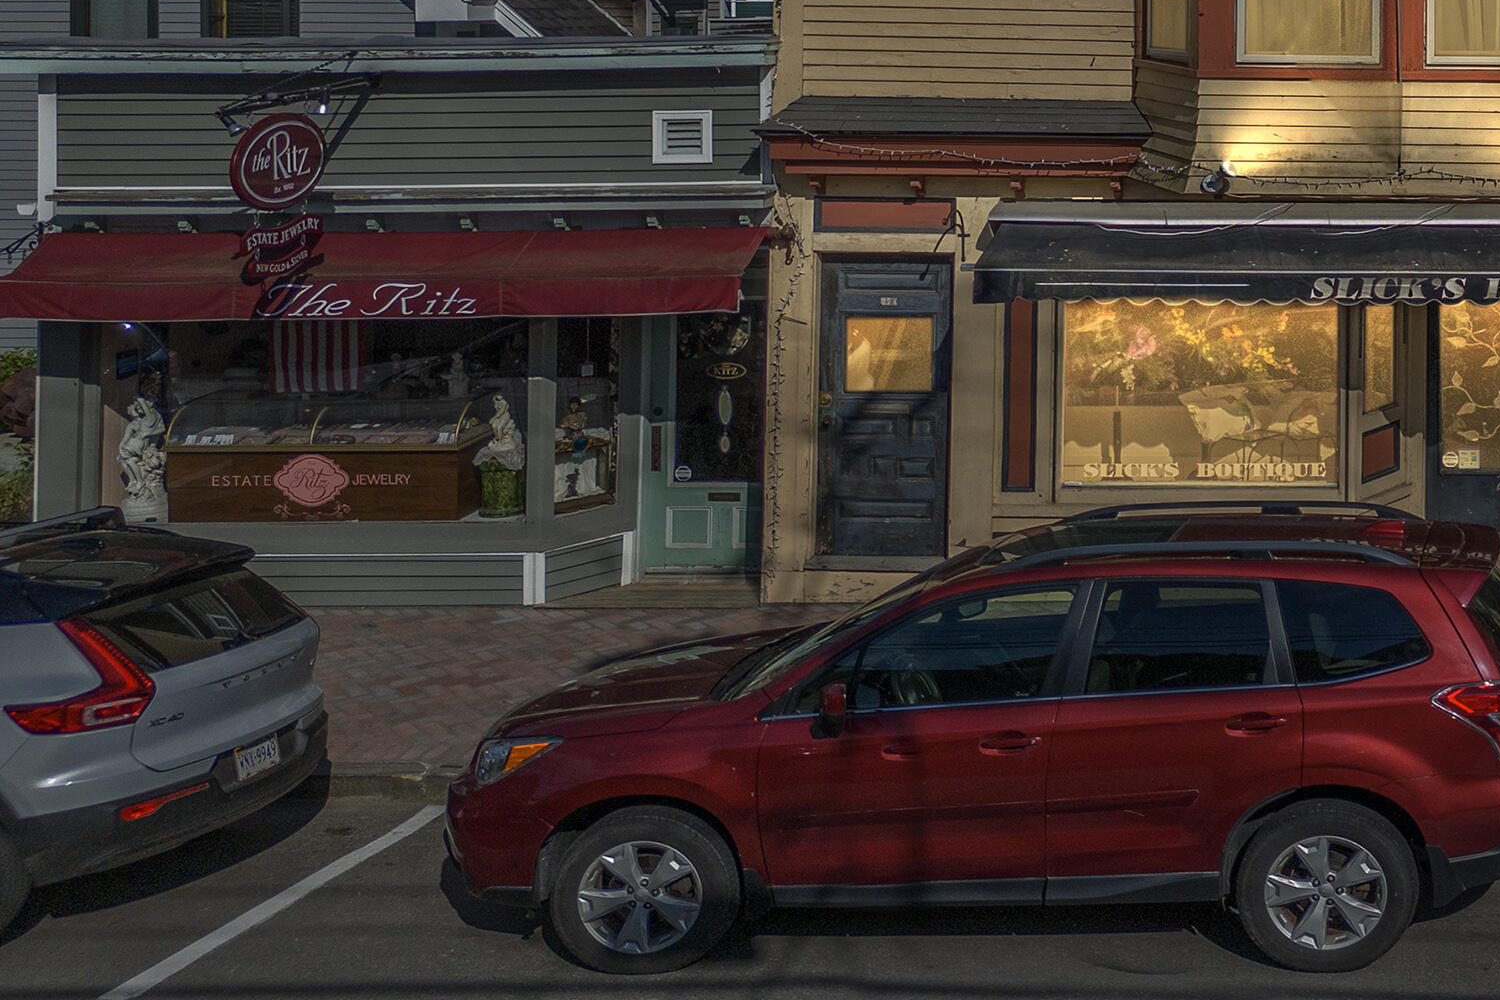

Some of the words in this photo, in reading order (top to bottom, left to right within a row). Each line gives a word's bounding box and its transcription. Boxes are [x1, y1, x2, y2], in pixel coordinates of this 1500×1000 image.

[252, 148, 271, 173] the
[266, 130, 311, 181] Ritz
[246, 231, 279, 252] ESTATE
[280, 217, 320, 243] JEWELRY
[256, 263, 269, 273] NEW
[269, 263, 286, 273] GOLD
[290, 249, 309, 267] SILVER
[256, 282, 352, 317] The
[360, 282, 477, 316] Ritz
[1310, 276, 1468, 302] SLICK'S
[211, 475, 272, 487] ESTATE
[290, 467, 334, 499] Ritz
[352, 473, 411, 486] JEWELRY
[1082, 462, 1180, 479] SLICK'S
[1195, 461, 1328, 483] BOUTIQUE
